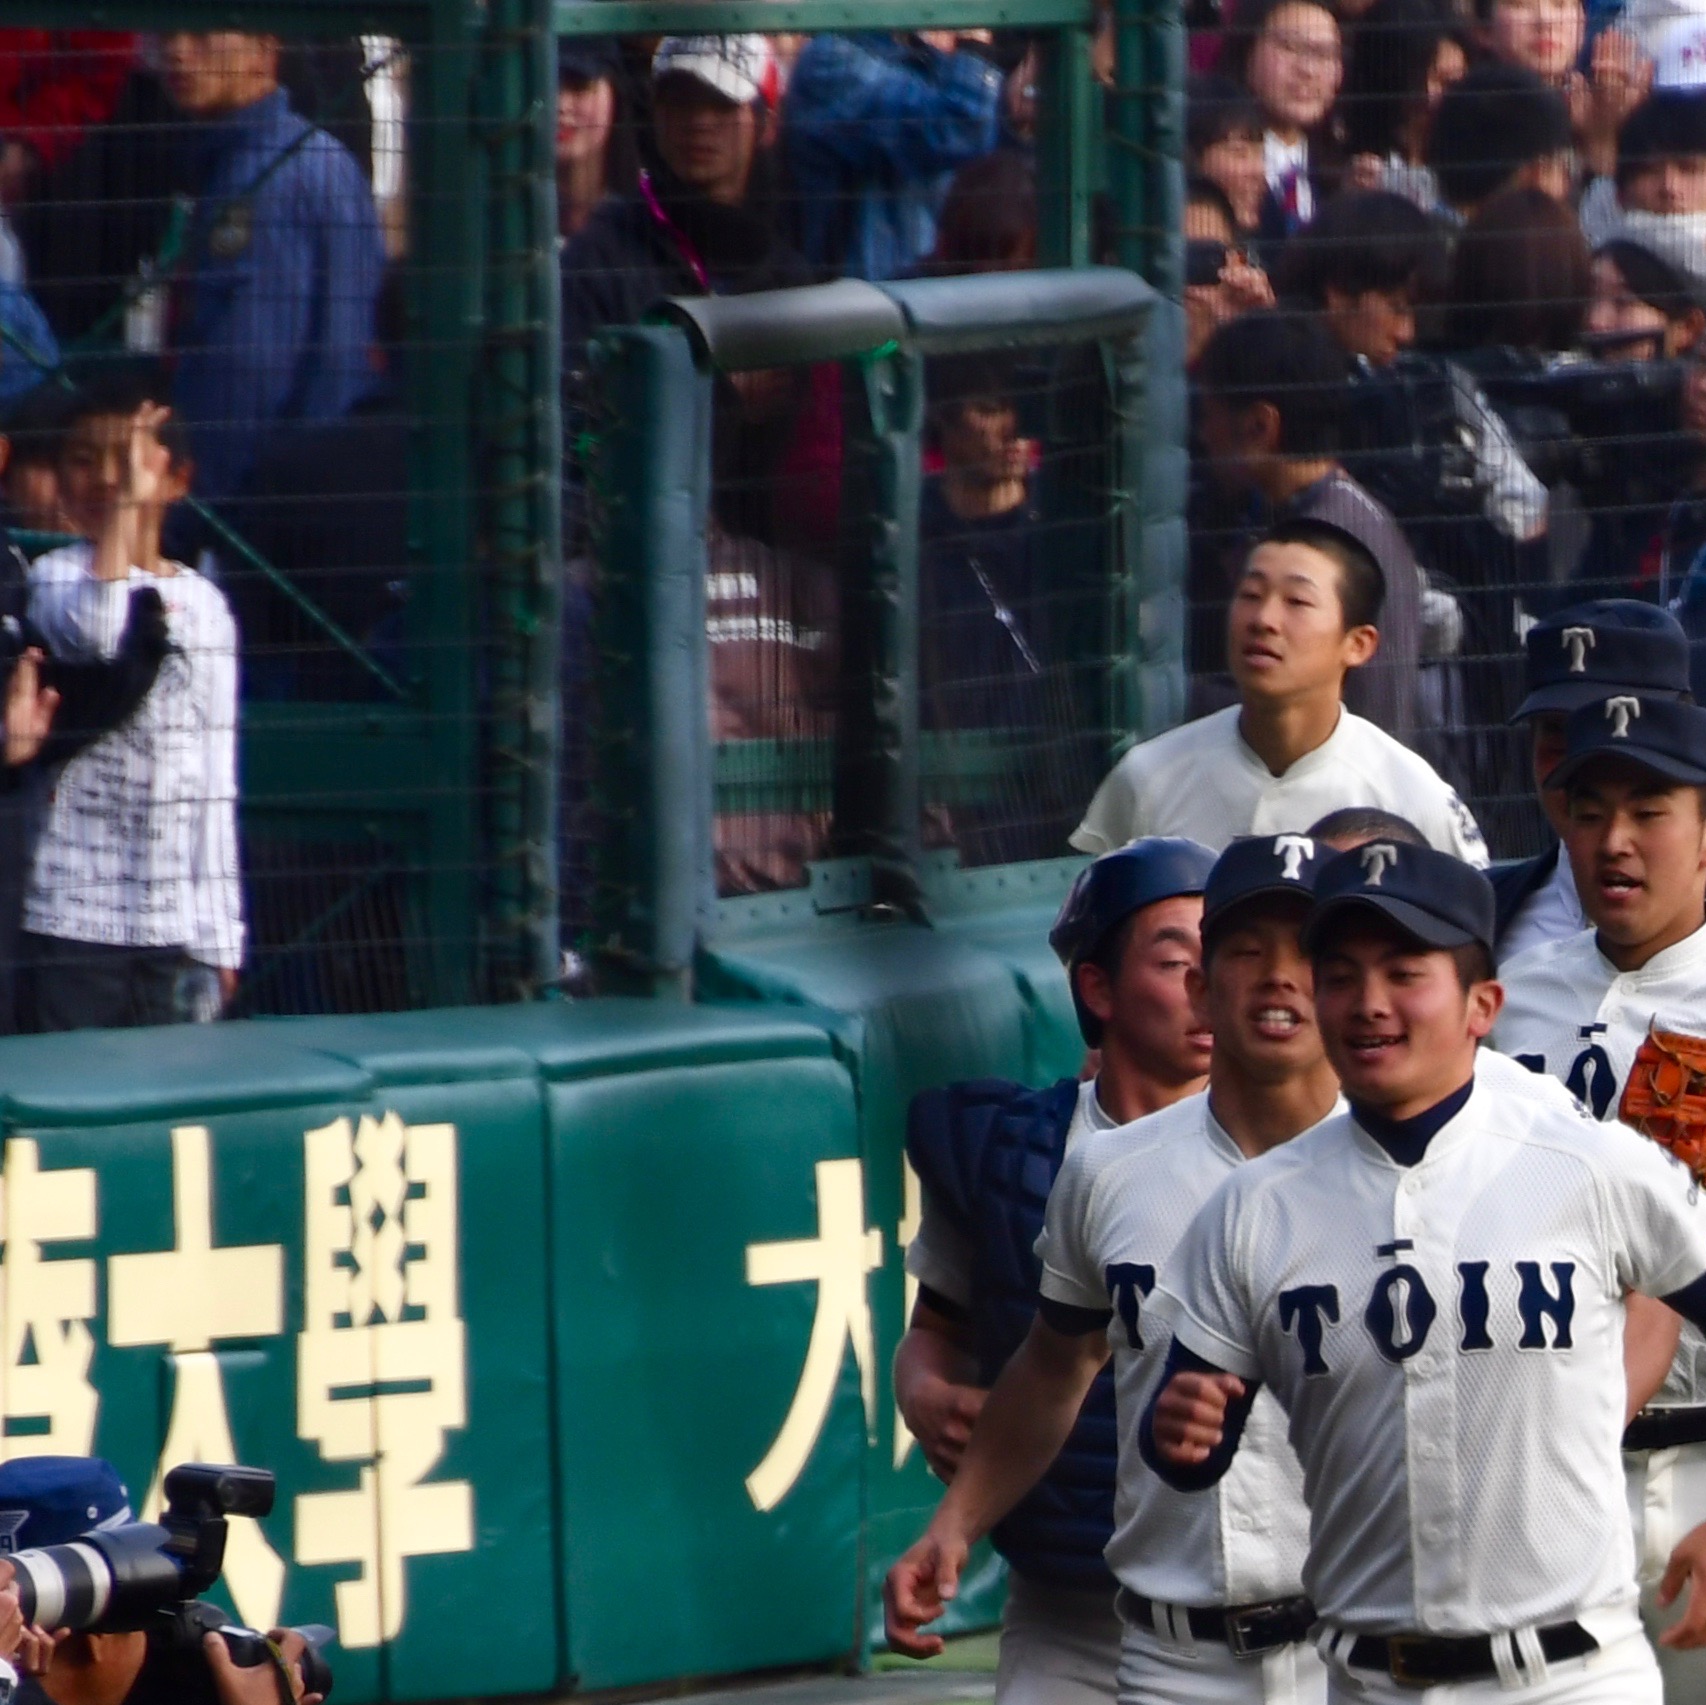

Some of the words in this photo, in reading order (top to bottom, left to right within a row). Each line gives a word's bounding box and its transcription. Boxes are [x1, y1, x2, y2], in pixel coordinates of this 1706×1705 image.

[1562, 626, 1596, 673] T
[1606, 695, 1641, 738] T
[1274, 834, 1315, 881] T
[1362, 843, 1398, 887] T
